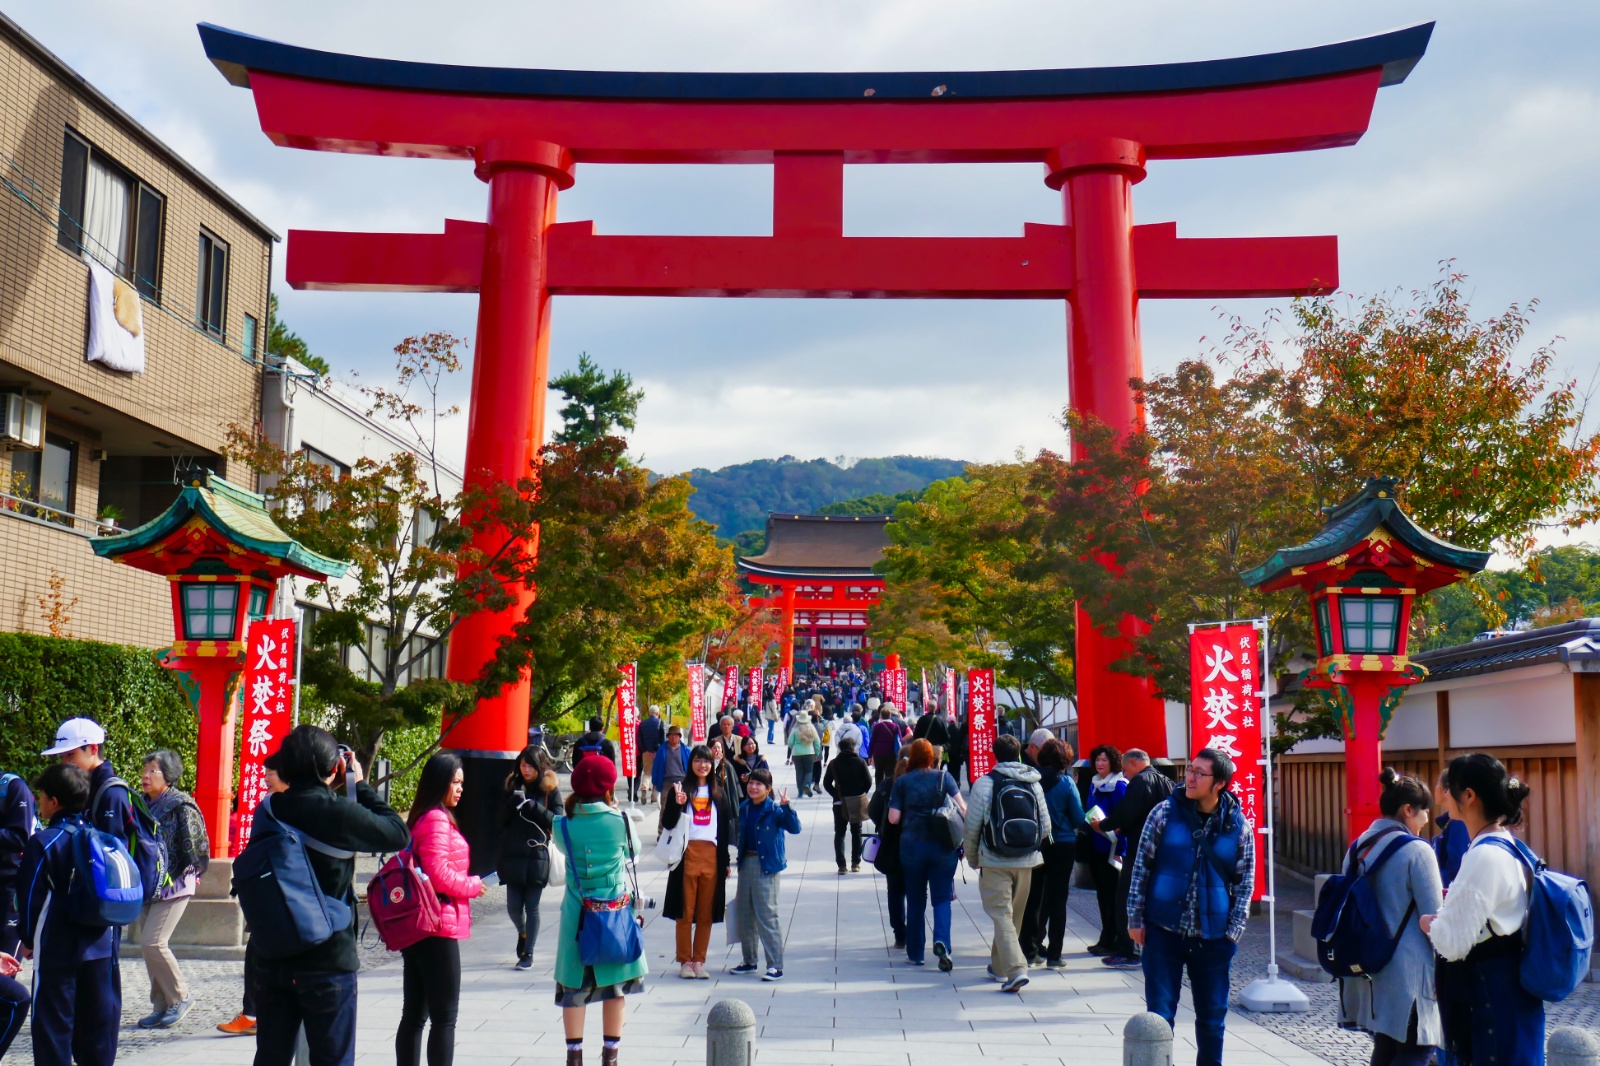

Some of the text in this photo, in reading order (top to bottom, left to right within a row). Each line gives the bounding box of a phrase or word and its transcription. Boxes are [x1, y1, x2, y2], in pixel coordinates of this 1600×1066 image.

[247, 634, 278, 756] 火焚祭
[275, 628, 290, 713] 伏見稲荷大社
[972, 675, 987, 731] 火焚祭
[1239, 636, 1255, 729] 伏見稲荷大社
[248, 762, 259, 811] 火焚神事
[1245, 772, 1257, 829] 十一月八日
